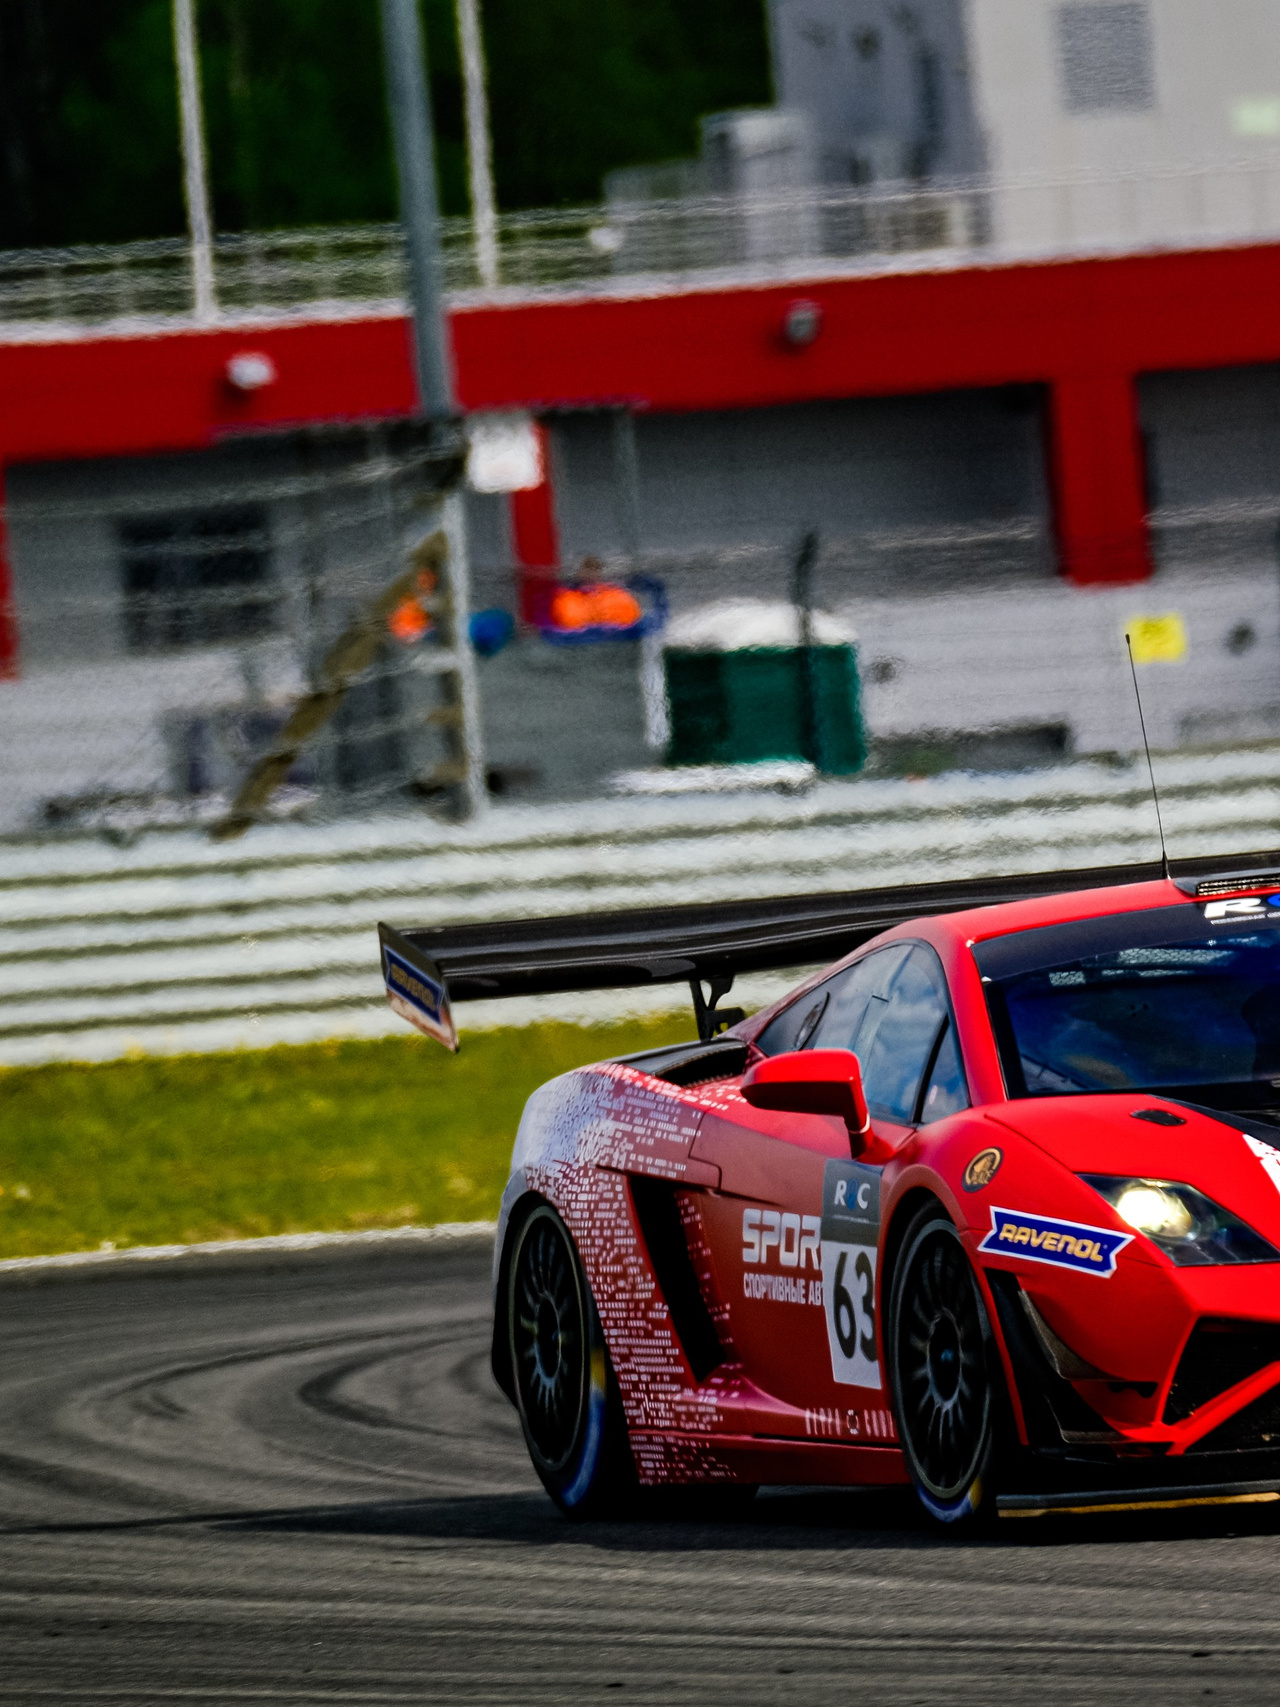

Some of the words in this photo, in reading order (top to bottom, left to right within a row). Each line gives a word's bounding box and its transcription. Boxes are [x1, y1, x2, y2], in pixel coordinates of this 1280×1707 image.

[998, 1222, 1104, 1263] RAVENOL
[744, 1272, 806, 1304] СПОРТИВНЫЕ
[833, 1250, 877, 1362] 63
